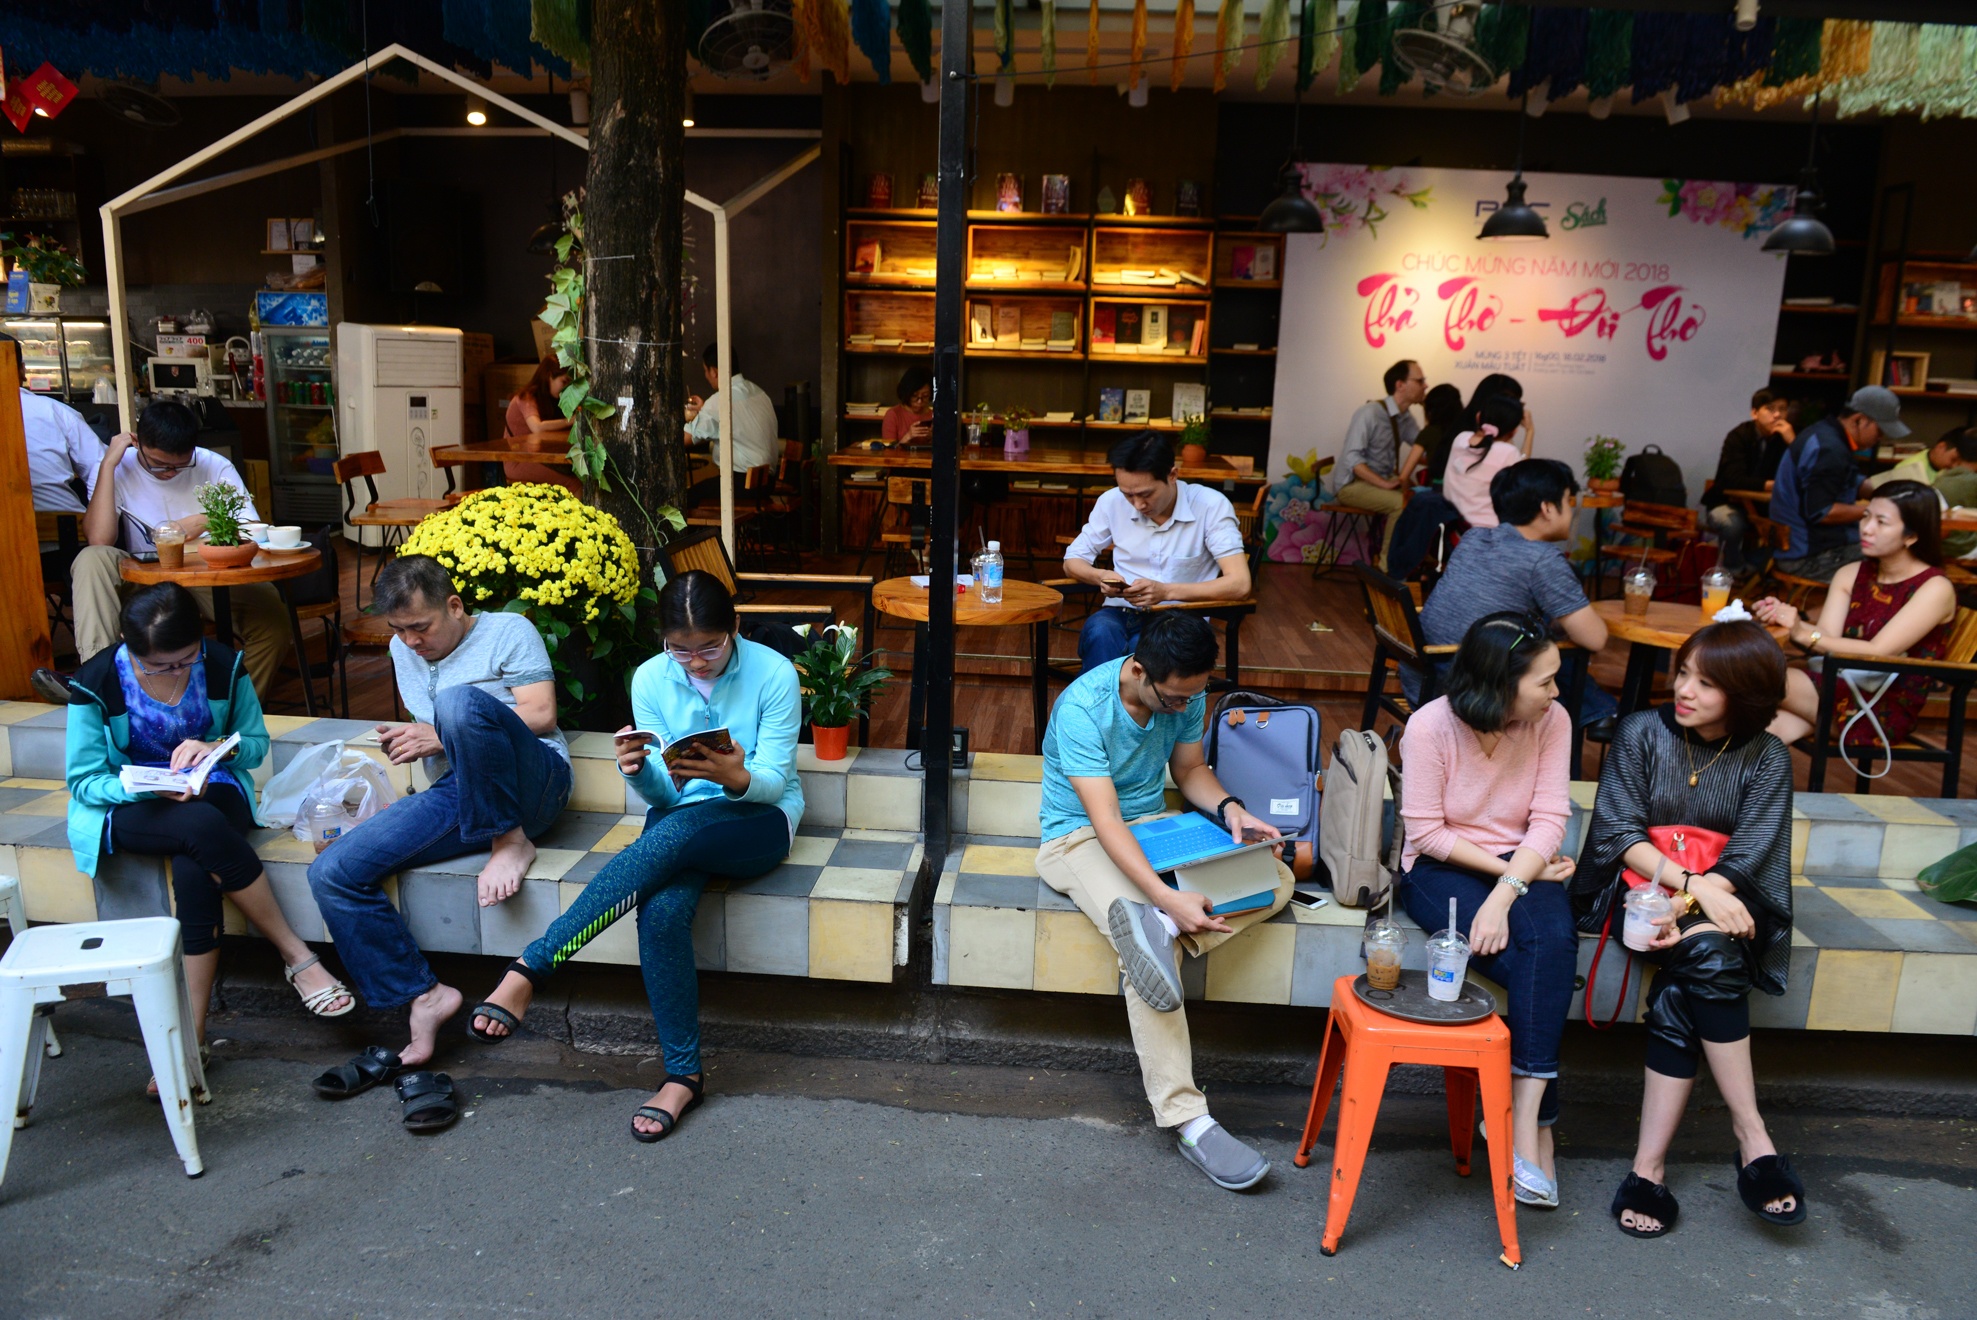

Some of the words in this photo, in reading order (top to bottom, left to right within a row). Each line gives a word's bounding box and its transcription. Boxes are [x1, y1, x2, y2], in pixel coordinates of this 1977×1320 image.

[1401, 251, 1461, 273] CHÚC
[1531, 255, 1578, 278] NĂM
[1582, 257, 1620, 280] MỚI
[1624, 261, 1671, 283] 2018
[1357, 272, 1420, 349] Thả
[187, 337, 204, 345] 400
[617, 396, 634, 431] 7
